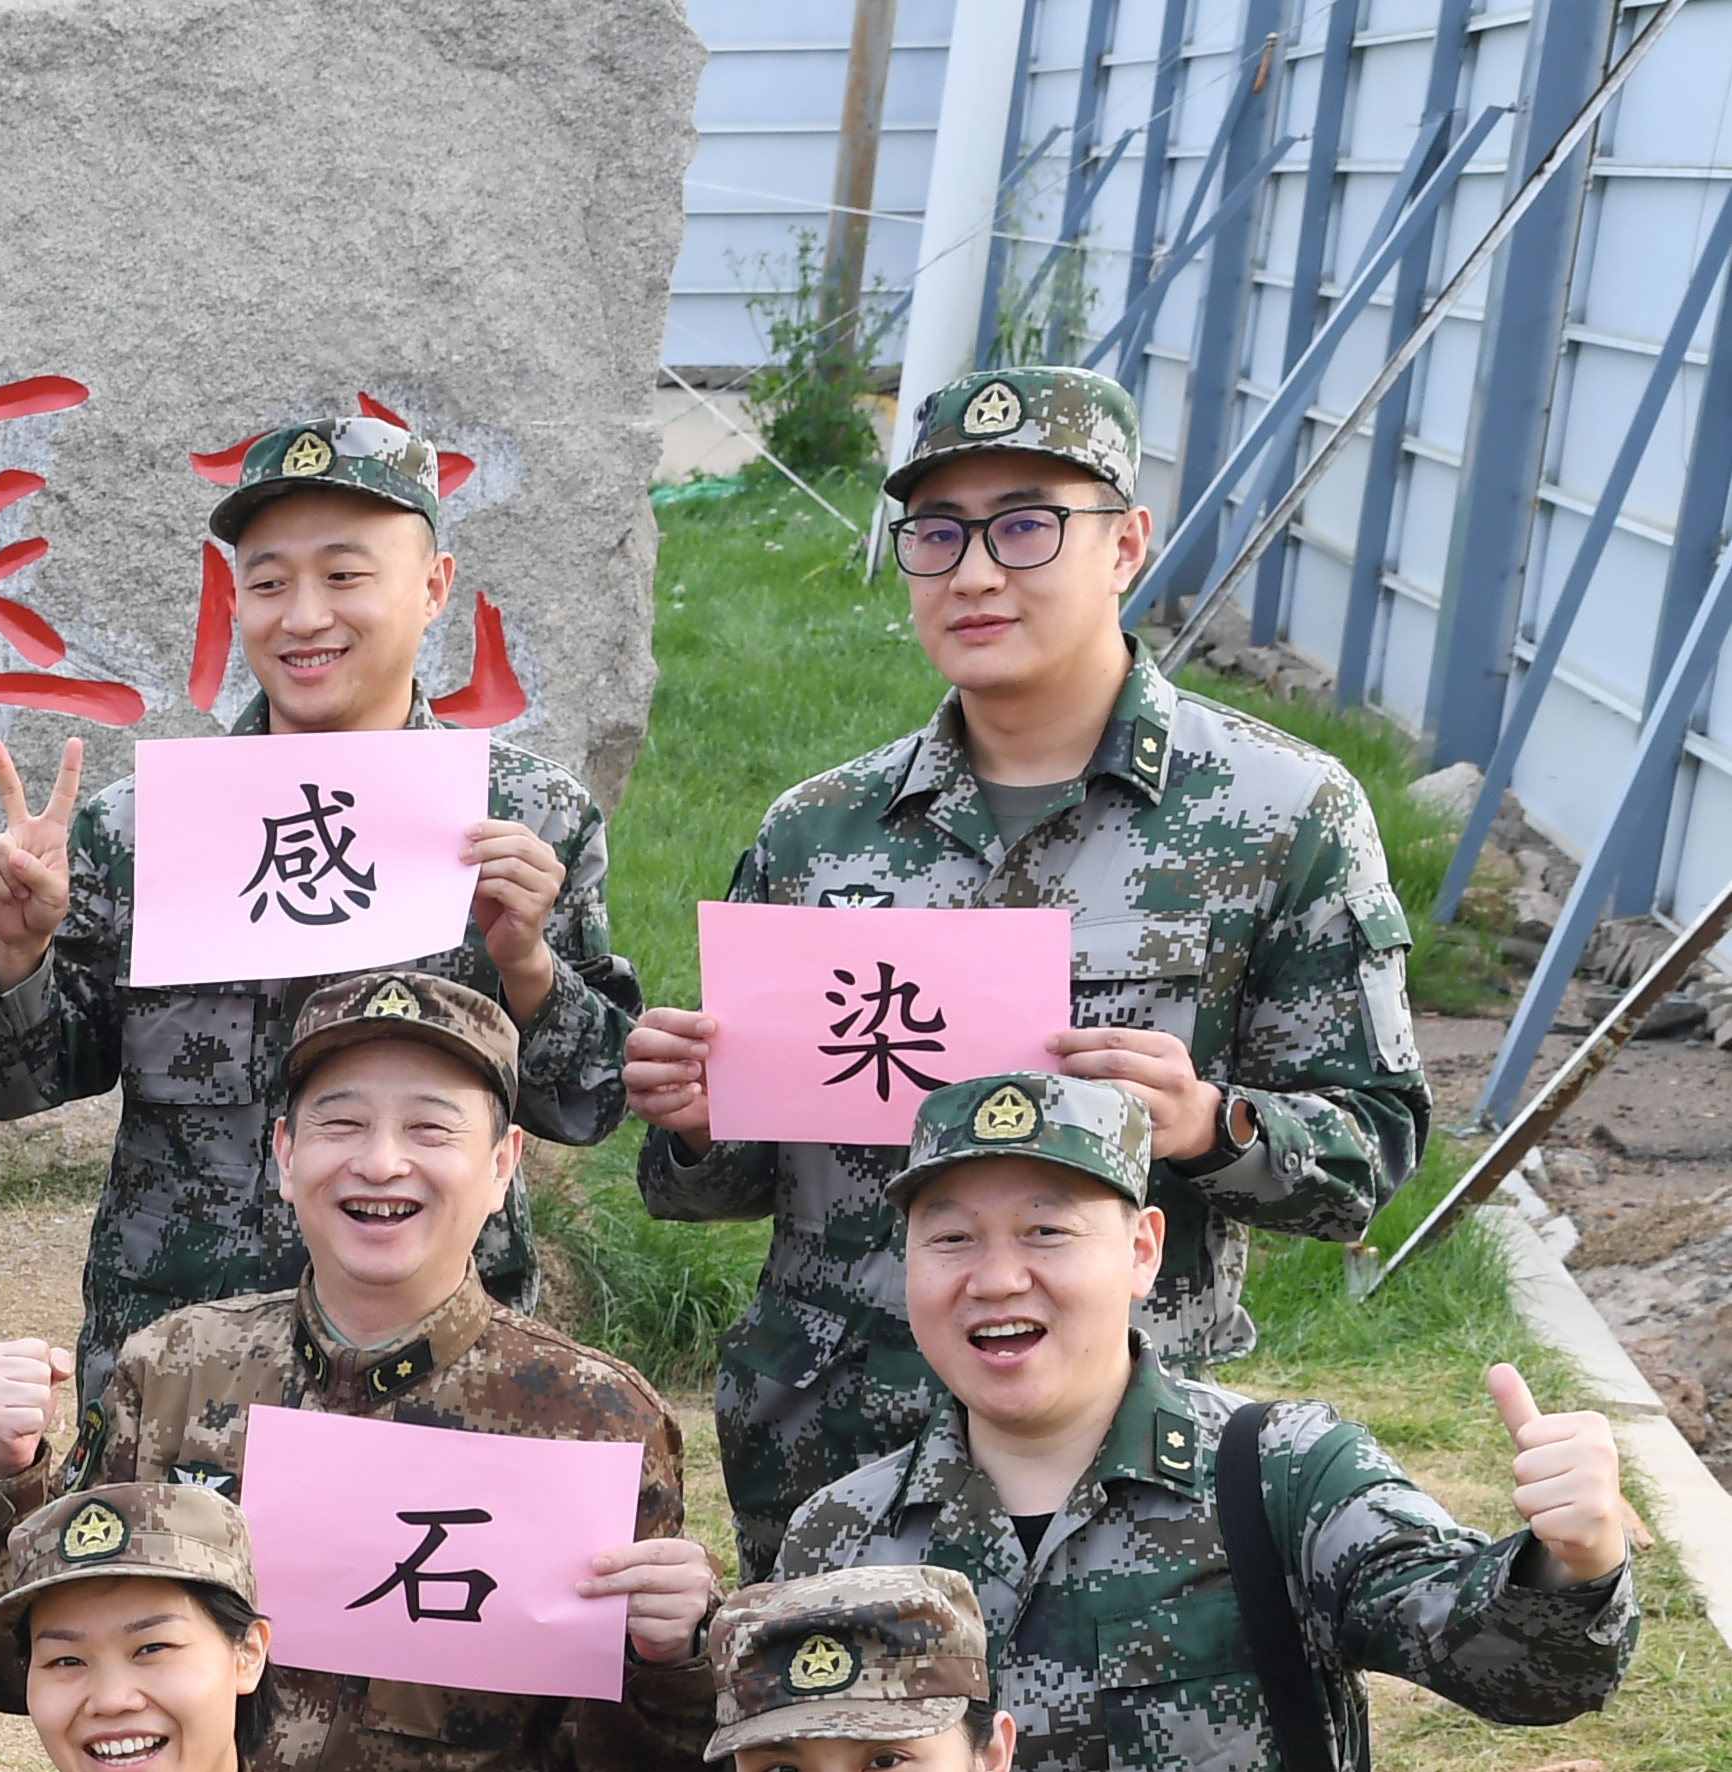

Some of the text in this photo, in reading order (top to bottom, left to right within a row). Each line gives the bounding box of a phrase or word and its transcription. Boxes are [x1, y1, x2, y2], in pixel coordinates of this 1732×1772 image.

[239, 783, 377, 926] 感
[817, 961, 952, 1103] 染
[344, 1508, 499, 1624] 石
